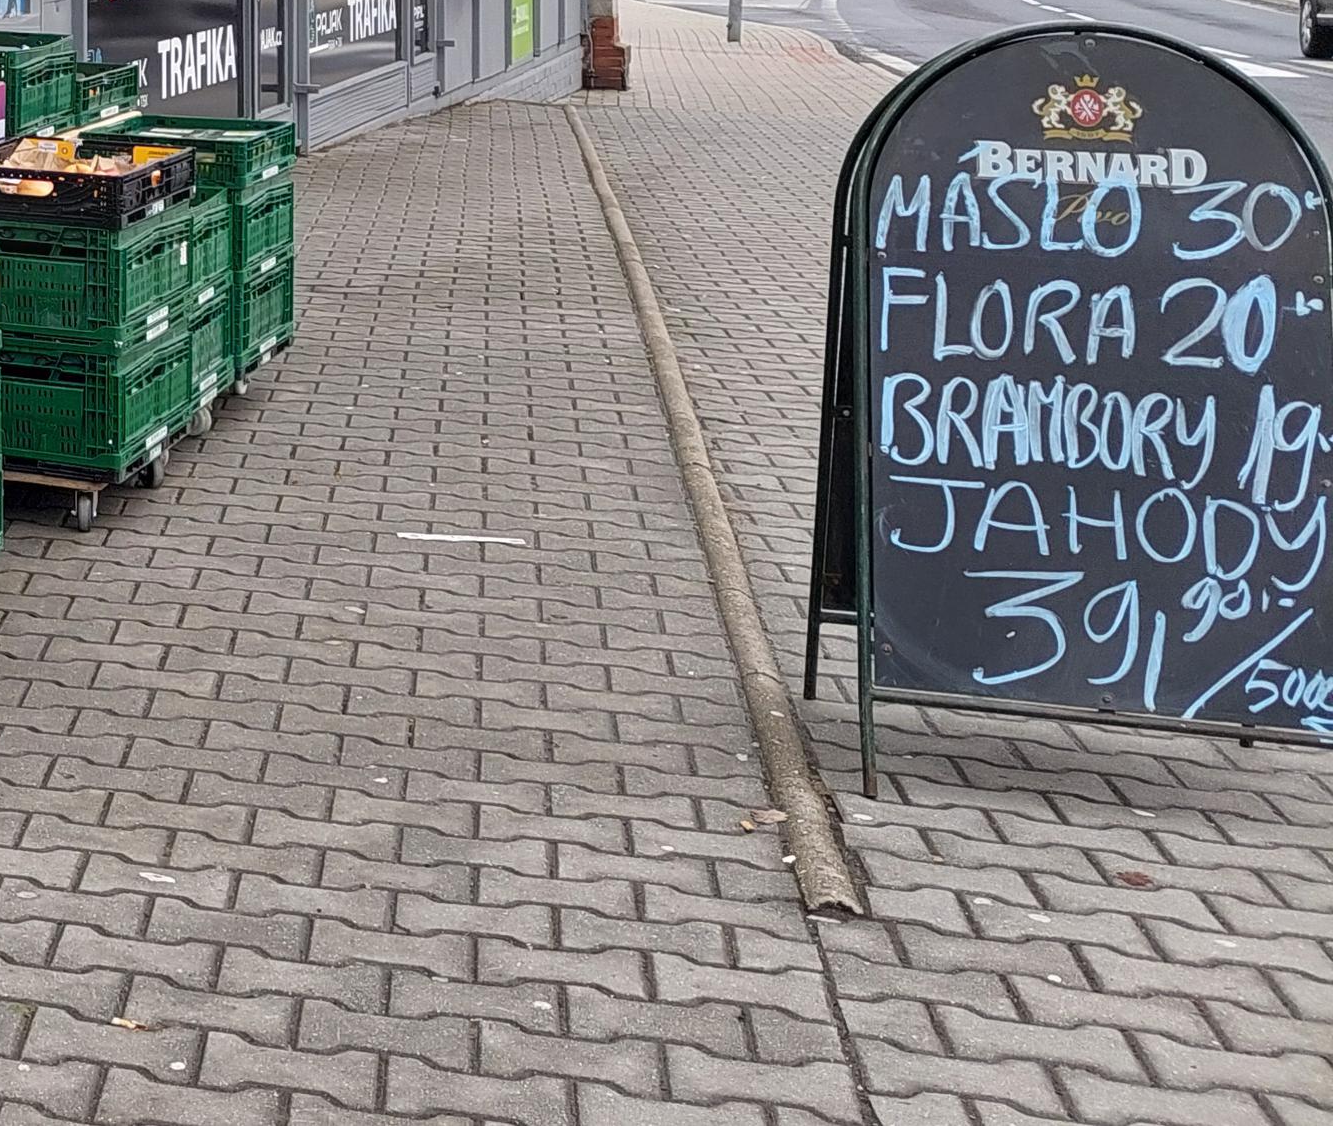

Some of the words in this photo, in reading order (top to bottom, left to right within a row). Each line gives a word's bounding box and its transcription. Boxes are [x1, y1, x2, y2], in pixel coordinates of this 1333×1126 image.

[157, 24, 237, 100] TRAFIKA
[976, 140, 1208, 188] BERNARD
[1055, 192, 1130, 225] Pvo
[882, 266, 1136, 365] FLORA
[880, 374, 1216, 491] BRAMBORY
[889, 475, 1327, 591] JAHODY
